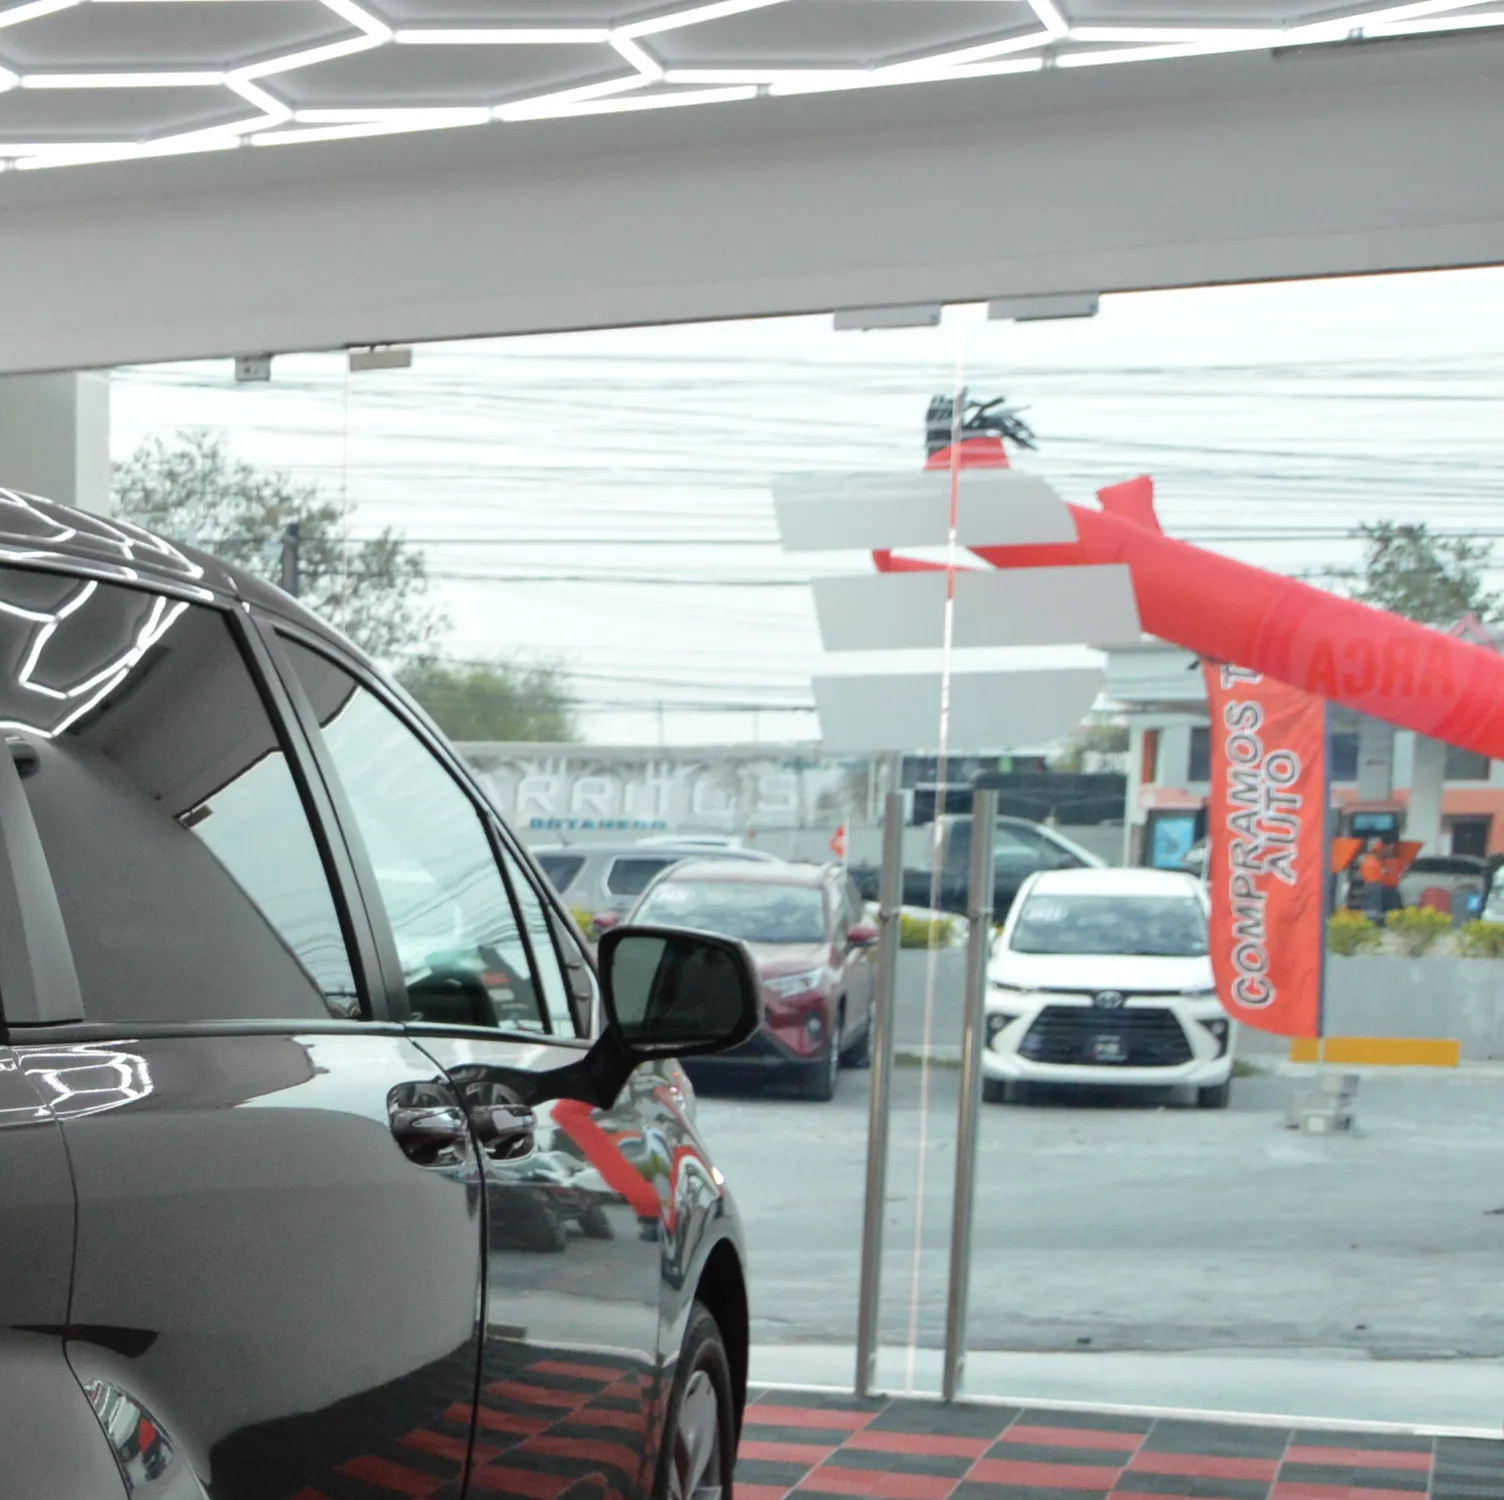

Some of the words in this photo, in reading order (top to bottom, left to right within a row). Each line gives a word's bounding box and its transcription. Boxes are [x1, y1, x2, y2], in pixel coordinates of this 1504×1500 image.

[1220, 663, 1264, 691] T
[1224, 700, 1276, 1008] COMPRAMOS
[1263, 749, 1303, 885] AUTO
